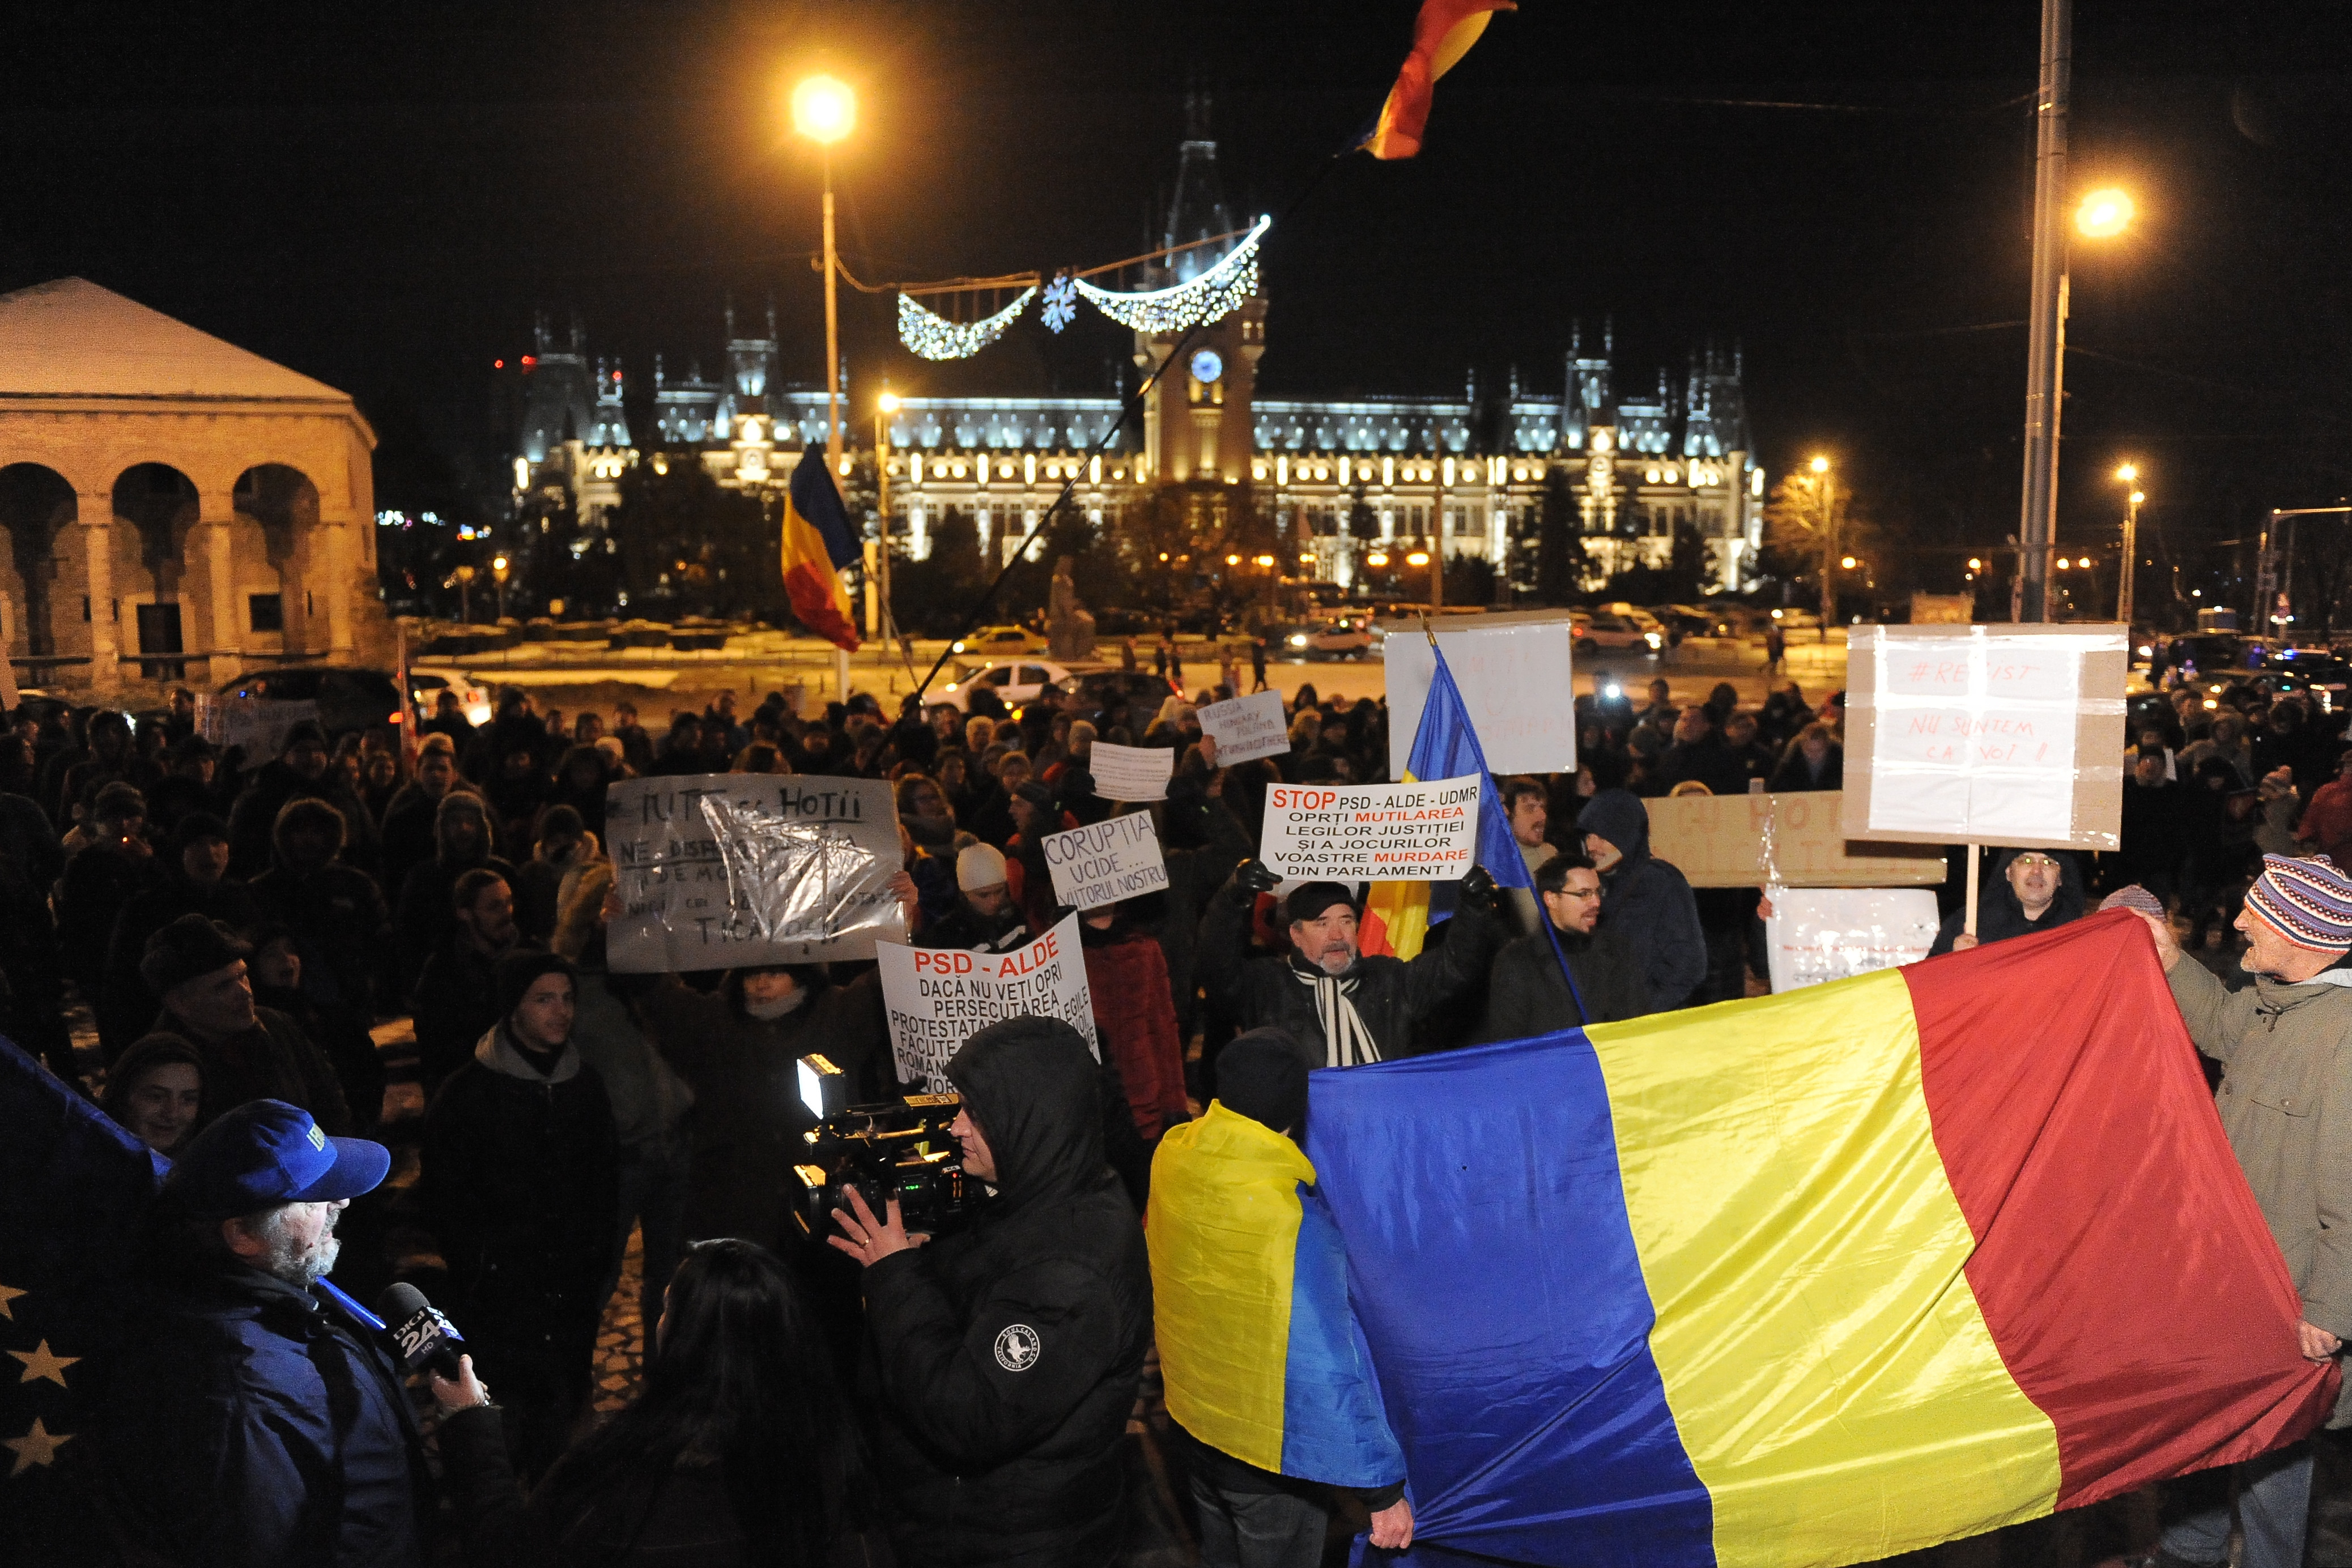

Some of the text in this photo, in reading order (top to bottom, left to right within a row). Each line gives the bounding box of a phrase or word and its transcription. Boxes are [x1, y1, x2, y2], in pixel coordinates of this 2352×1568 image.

[1908, 661, 2041, 684] #REIST
[1908, 713, 2035, 737] NU SUNTEM
[1926, 744, 1953, 760] CA
[1273, 789, 1336, 810] STOP
[1339, 796, 1371, 809] PSD
[1384, 794, 1426, 808] ALDE
[1439, 786, 1478, 806] UDMR
[1355, 807, 1464, 822] MUTILAREA
[1286, 826, 1372, 836] LEGILOR
[1321, 840, 1334, 849] A
[1339, 837, 1451, 849] JOCURILOR
[1274, 849, 1468, 863] VOASTRE MURDARE
[1117, 864, 1167, 894] NOSTRU
[1287, 866, 1319, 875] DIN
[1326, 865, 1444, 876] PARLAMENT
[914, 951, 972, 975] PSD
[998, 931, 1060, 978] ALDE
[919, 960, 1063, 1000] DACĂ NU VETI OPRI
[934, 989, 1060, 1019] PERSECUTAREA
[900, 1030, 956, 1057] FACUTE
[393, 1310, 425, 1340] DIGI
[401, 1320, 441, 1358] 24
